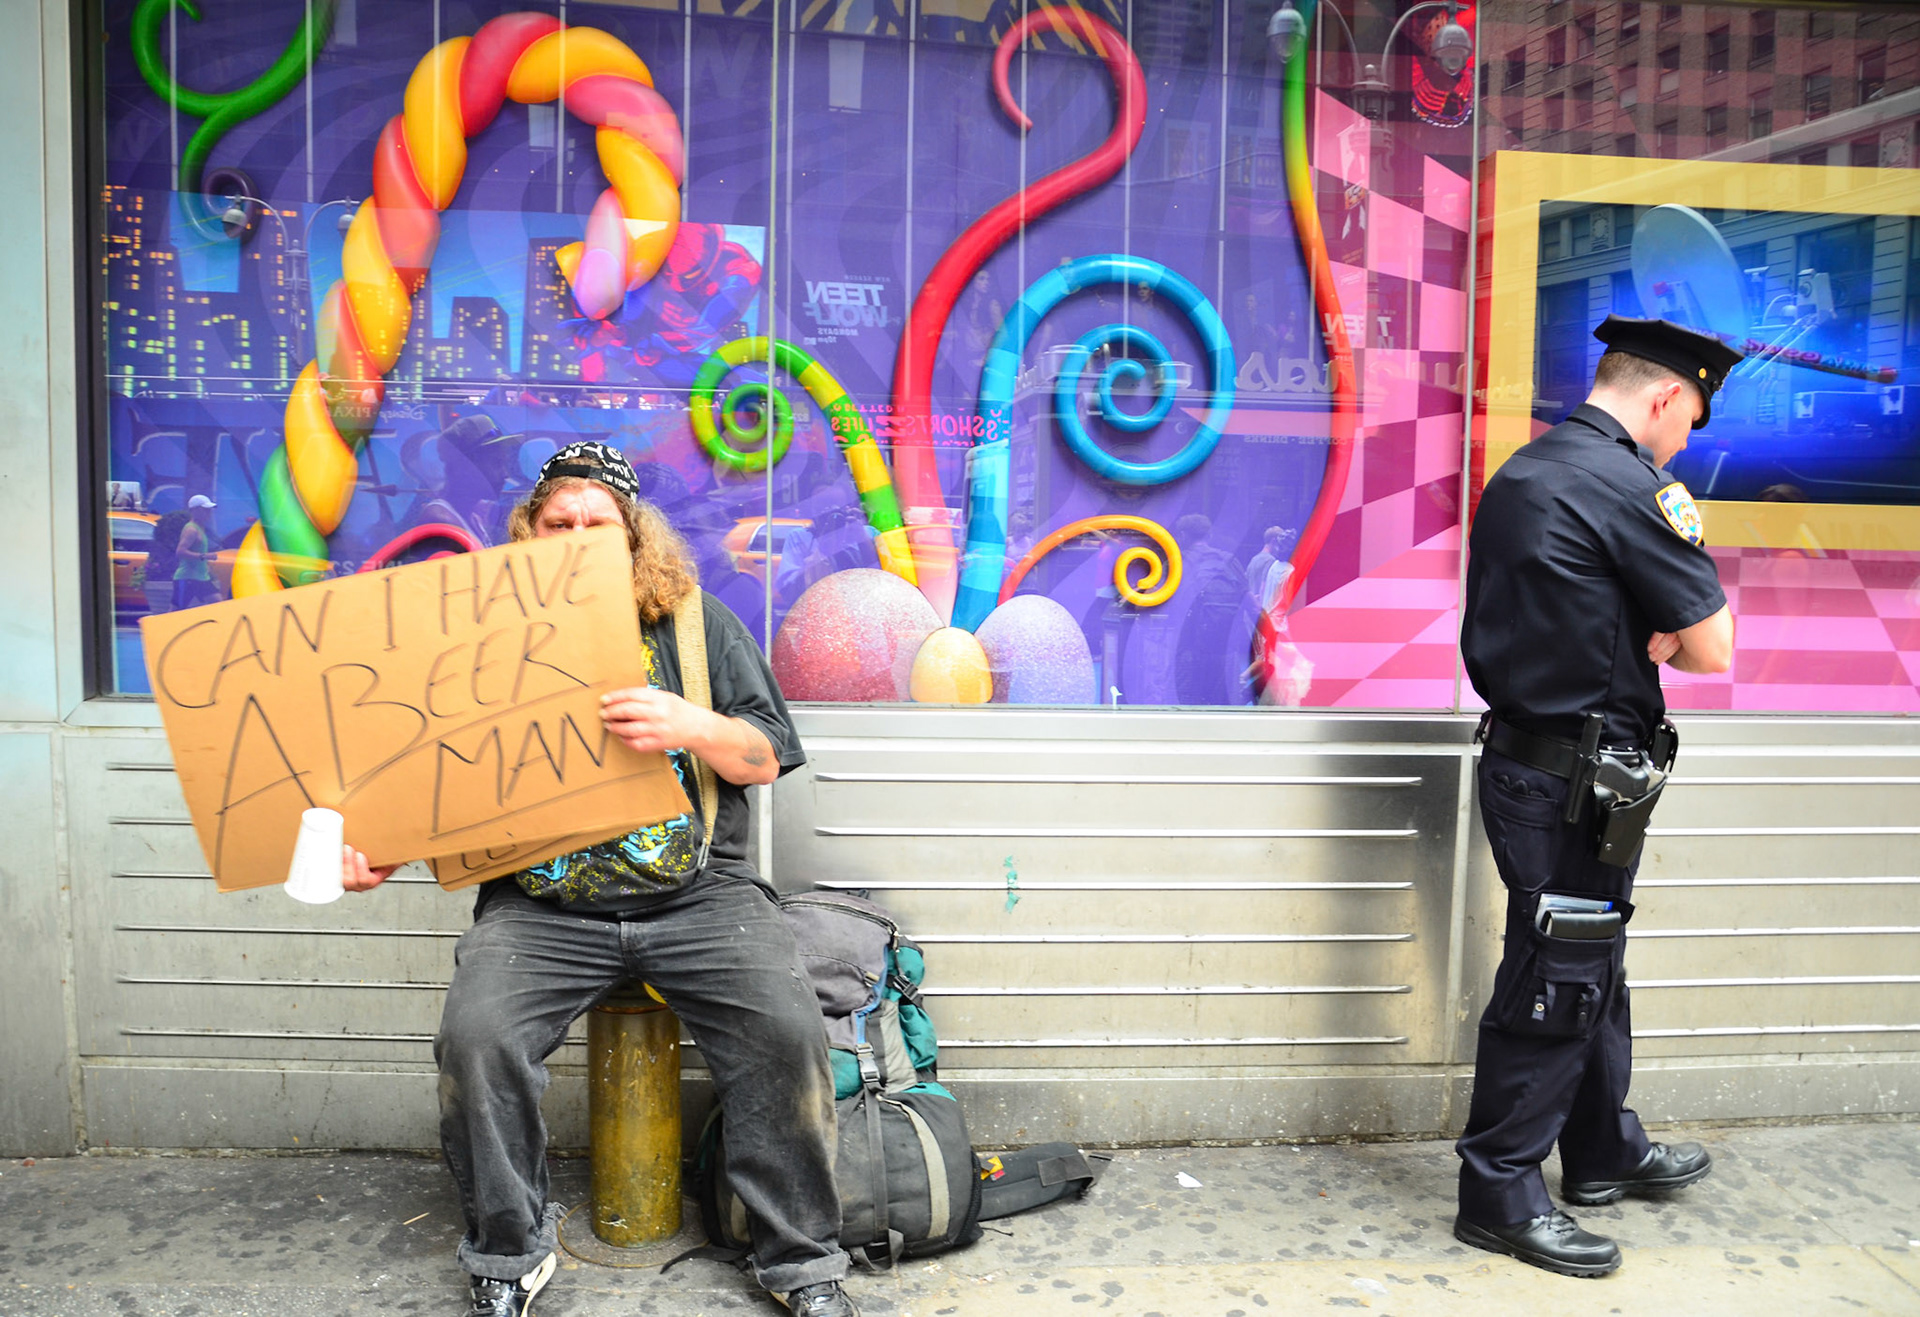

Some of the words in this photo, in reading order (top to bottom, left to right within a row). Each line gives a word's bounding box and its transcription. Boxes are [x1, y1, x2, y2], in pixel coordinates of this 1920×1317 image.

[157, 590, 333, 709] CAN
[382, 571, 400, 652] I
[440, 541, 601, 636] HAVE
[215, 693, 312, 880] A
[322, 622, 590, 792] BEER
[432, 712, 610, 835] MAN
